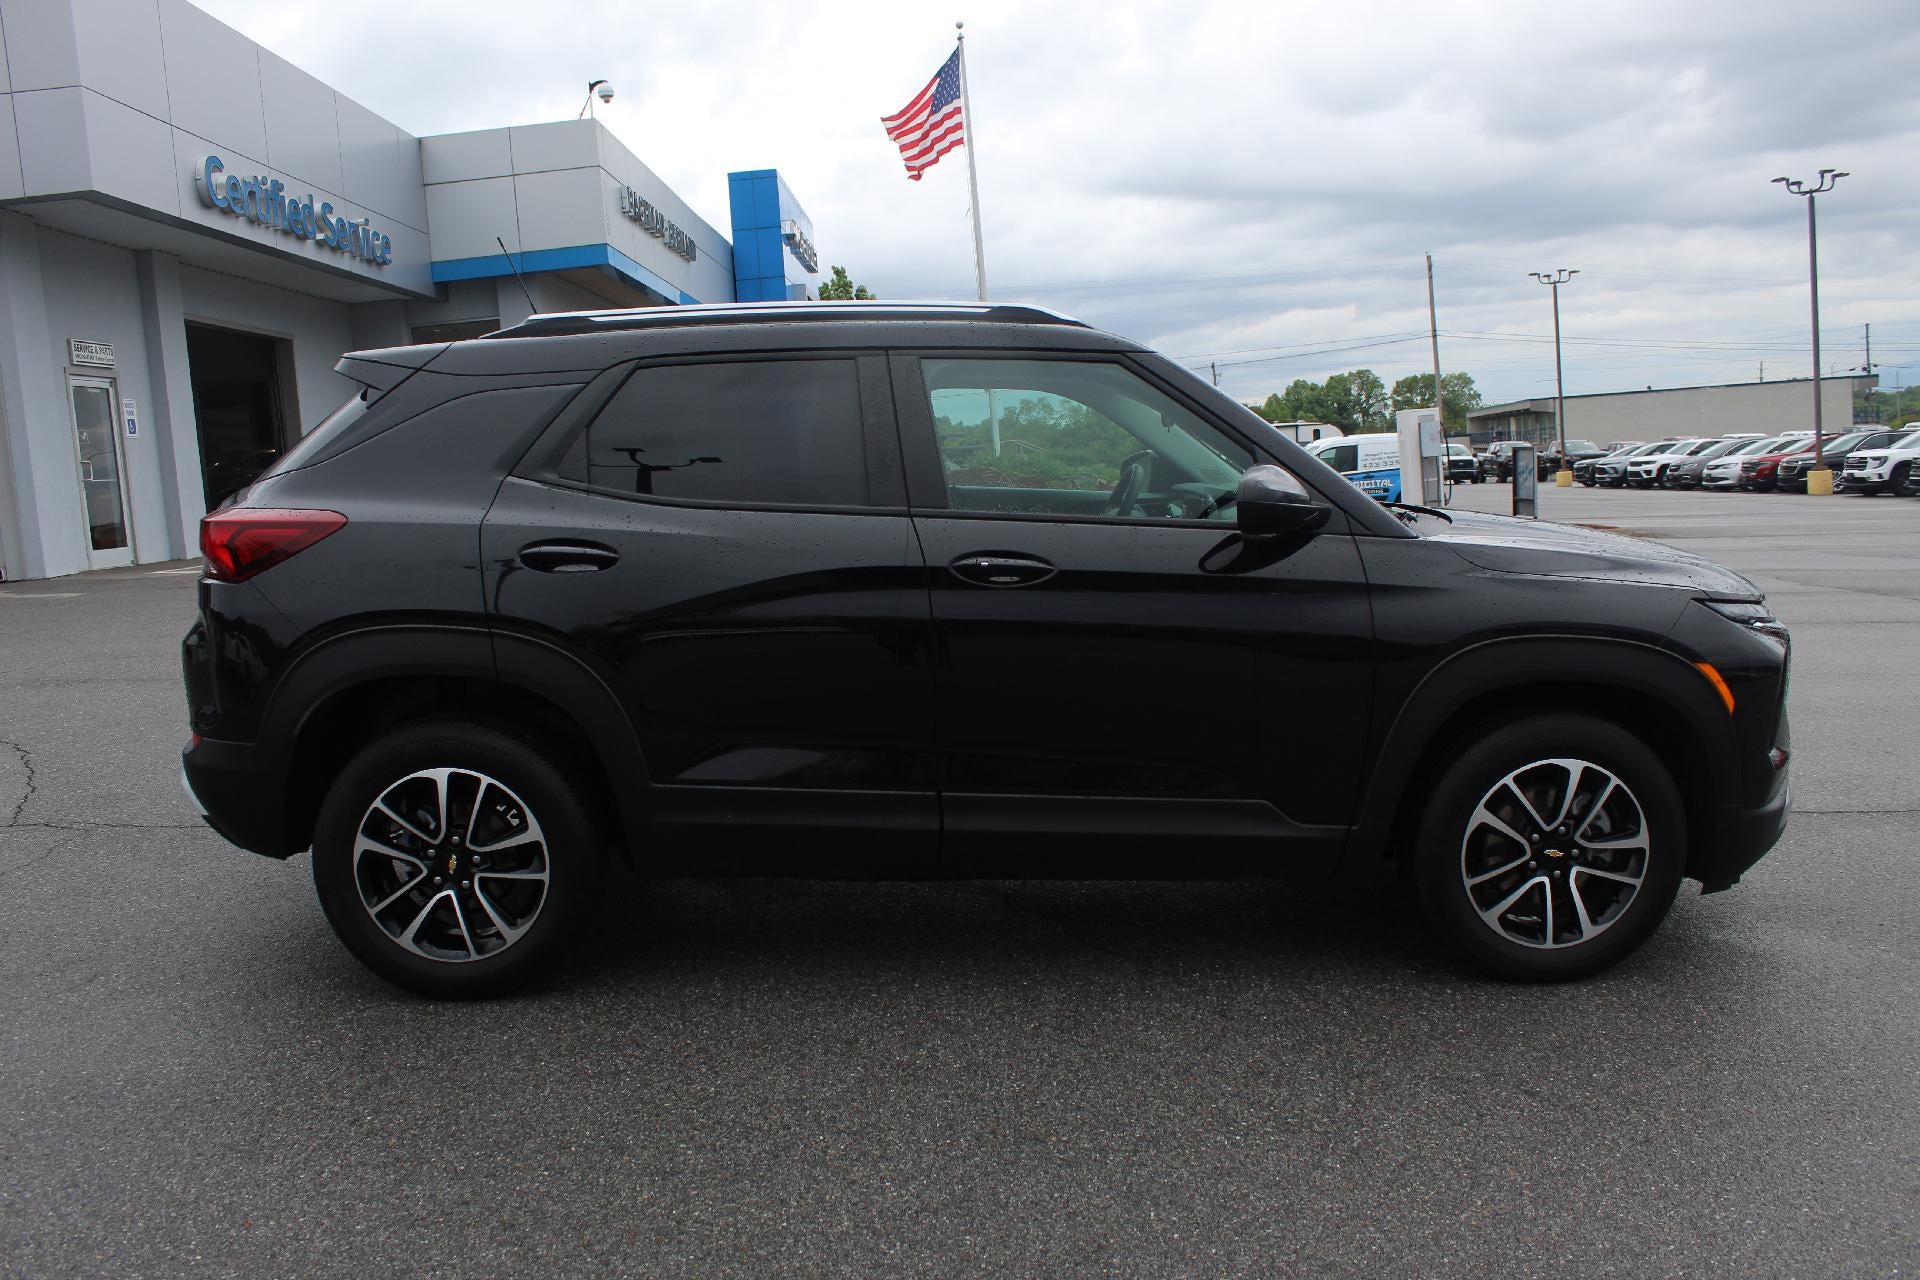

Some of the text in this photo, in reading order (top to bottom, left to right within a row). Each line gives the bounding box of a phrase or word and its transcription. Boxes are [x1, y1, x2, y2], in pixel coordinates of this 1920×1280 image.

[199, 155, 393, 266] Certified Service
[73, 343, 94, 354] SERVICE
[98, 346, 114, 356] PARTS
[1352, 479, 1394, 488] DIGITAL
